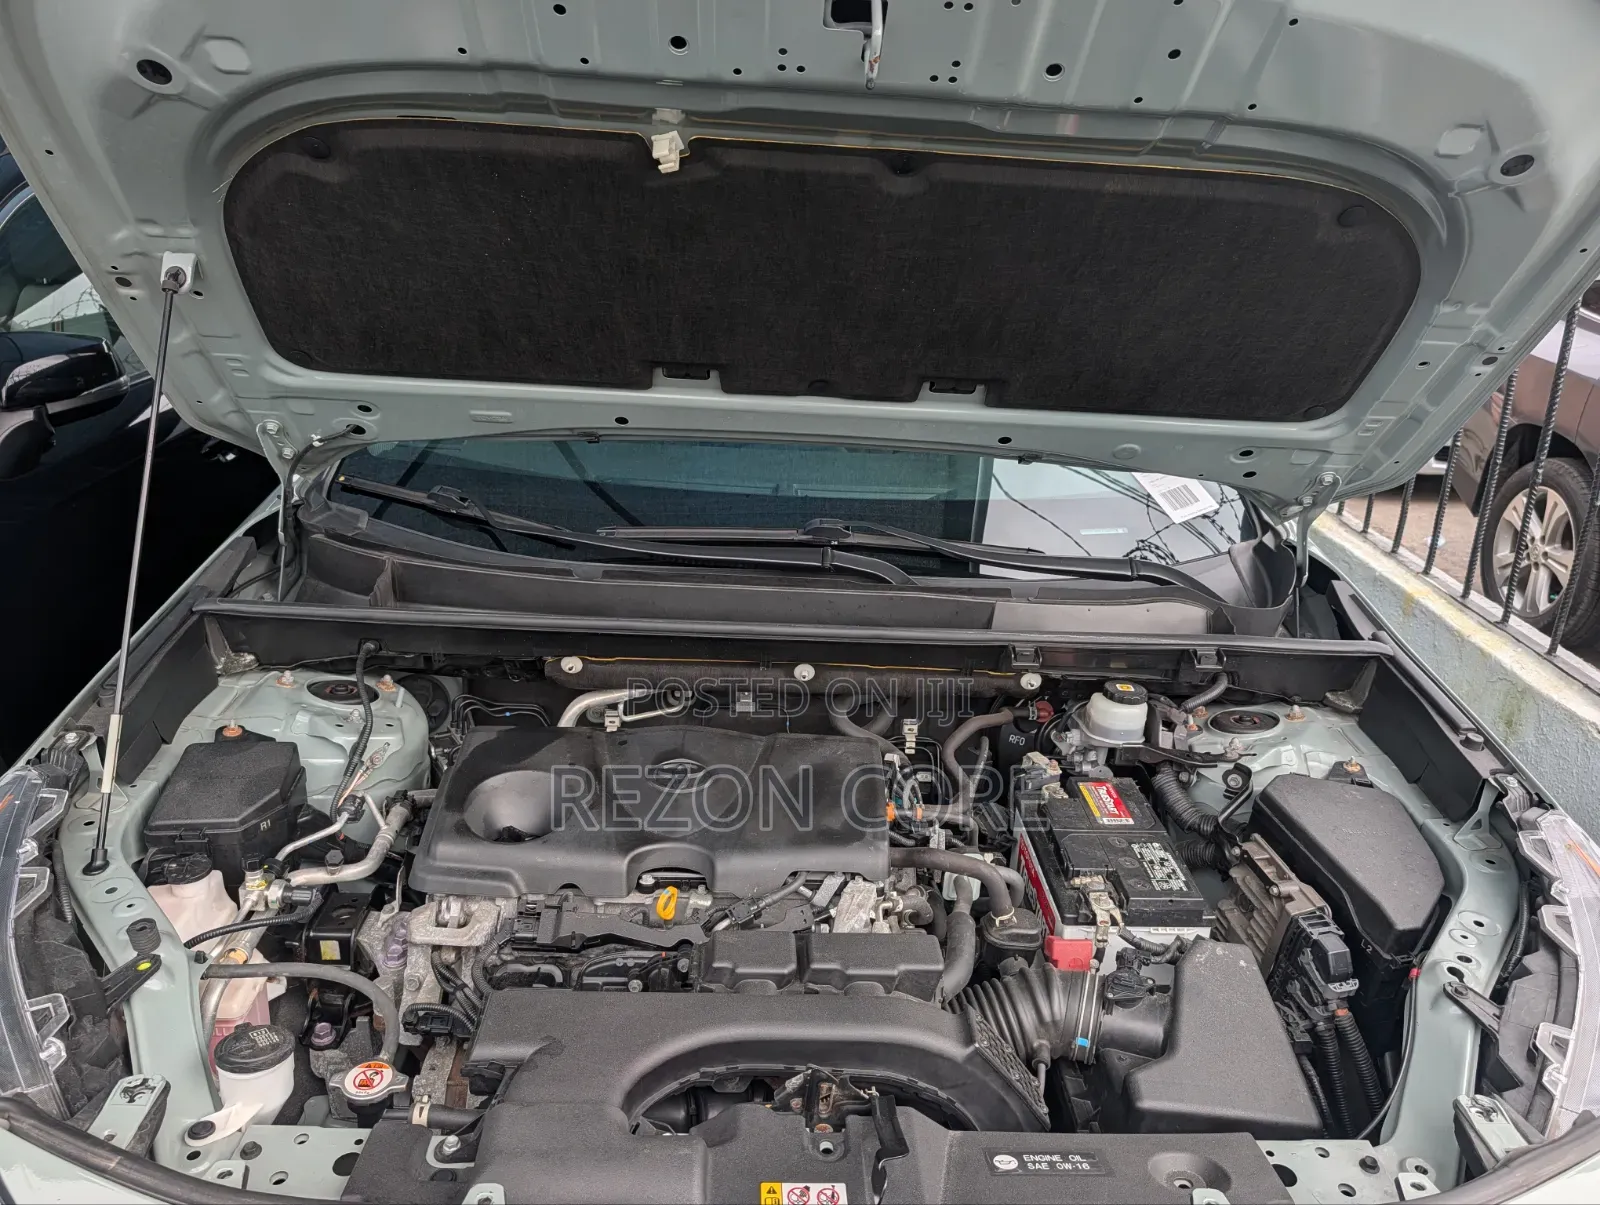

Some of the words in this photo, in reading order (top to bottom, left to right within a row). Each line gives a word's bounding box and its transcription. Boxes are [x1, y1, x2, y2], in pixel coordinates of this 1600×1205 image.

[260, 819, 271, 831] R1
[1022, 1154, 1063, 1162] ENGINE
[1068, 1154, 1087, 1162] OIL
[1027, 1162, 1050, 1170] SAE
